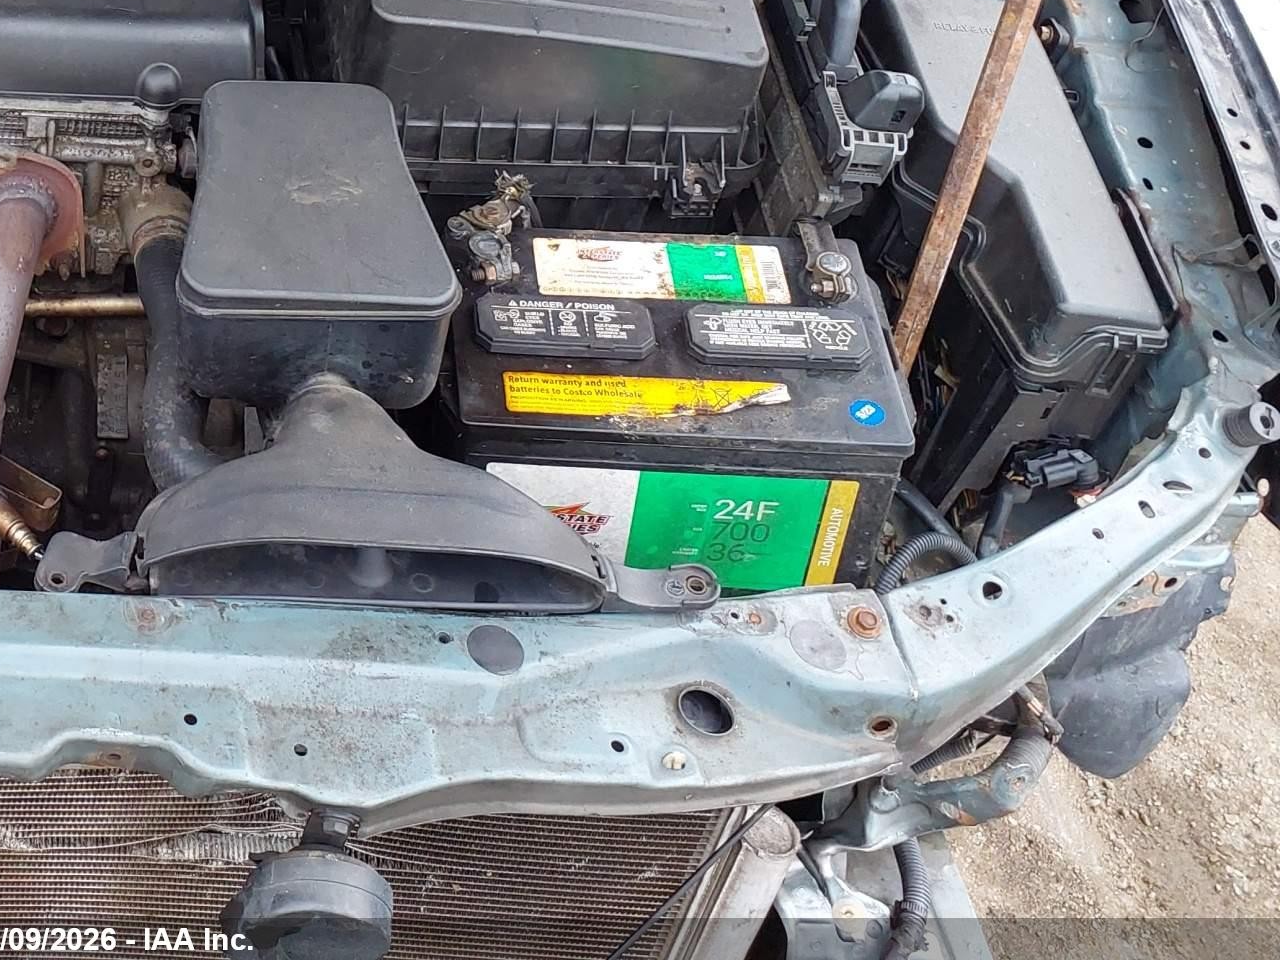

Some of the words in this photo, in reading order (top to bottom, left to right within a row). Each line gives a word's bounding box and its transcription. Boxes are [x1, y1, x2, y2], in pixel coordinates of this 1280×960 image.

[520, 300, 563, 310] DANGER
[574, 302, 615, 311] POISON
[508, 376, 539, 384] Return
[542, 378, 582, 388] warranty
[585, 378, 602, 387] and
[604, 379, 626, 389] used
[509, 384, 549, 394] batteries
[563, 388, 593, 396] Costco
[714, 499, 780, 521] 24F
[557, 513, 608, 524] STATE
[712, 521, 769, 543] 700
[817, 507, 844, 568] AUTOMOTIVE
